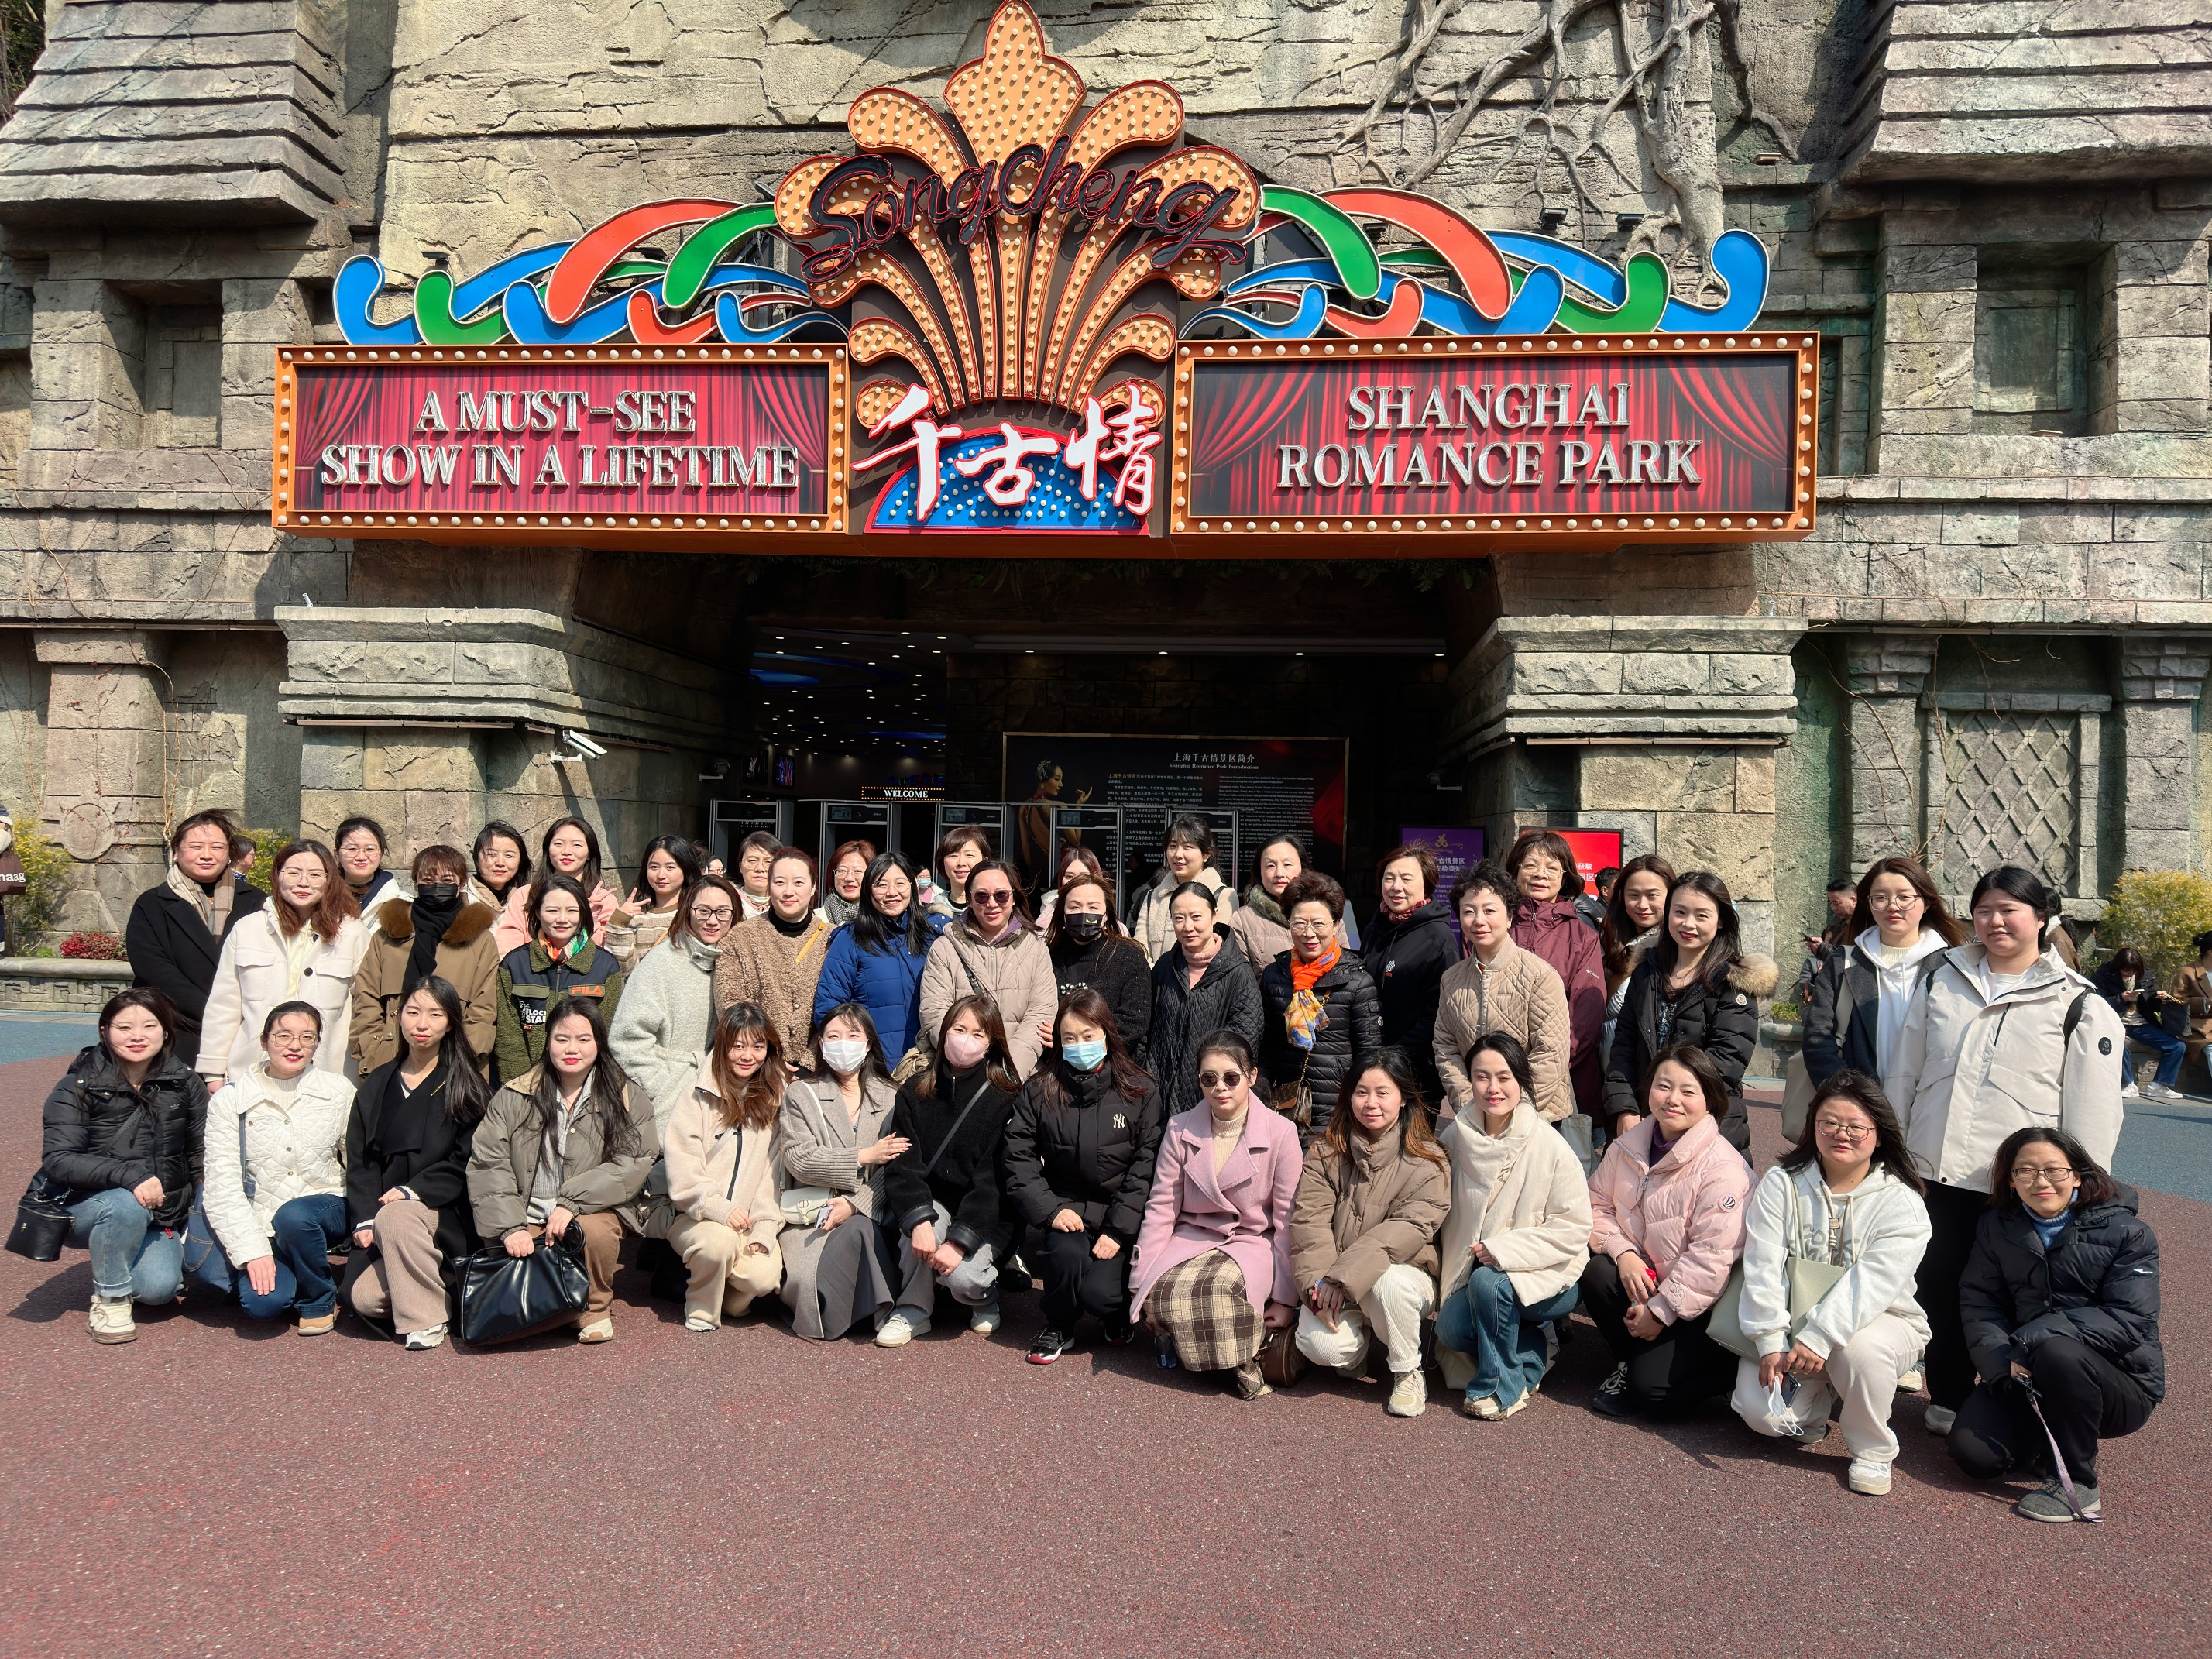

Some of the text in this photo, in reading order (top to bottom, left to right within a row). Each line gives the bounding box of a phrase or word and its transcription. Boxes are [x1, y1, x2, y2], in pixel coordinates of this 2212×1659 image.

[414, 390, 696, 433] A MUST-SEE
[1348, 382, 1632, 431] SHANGHAI
[321, 444, 798, 488] SHOW IN A LIFETIME
[850, 383, 1163, 522] 千古情
[1277, 439, 1703, 489] ROMANCE PARK
[1173, 752, 1255, 764] 上海千古情景区简介
[884, 789, 929, 798] WELCOME
[1575, 862, 1592, 871] 获取
[572, 985, 603, 996] FILA
